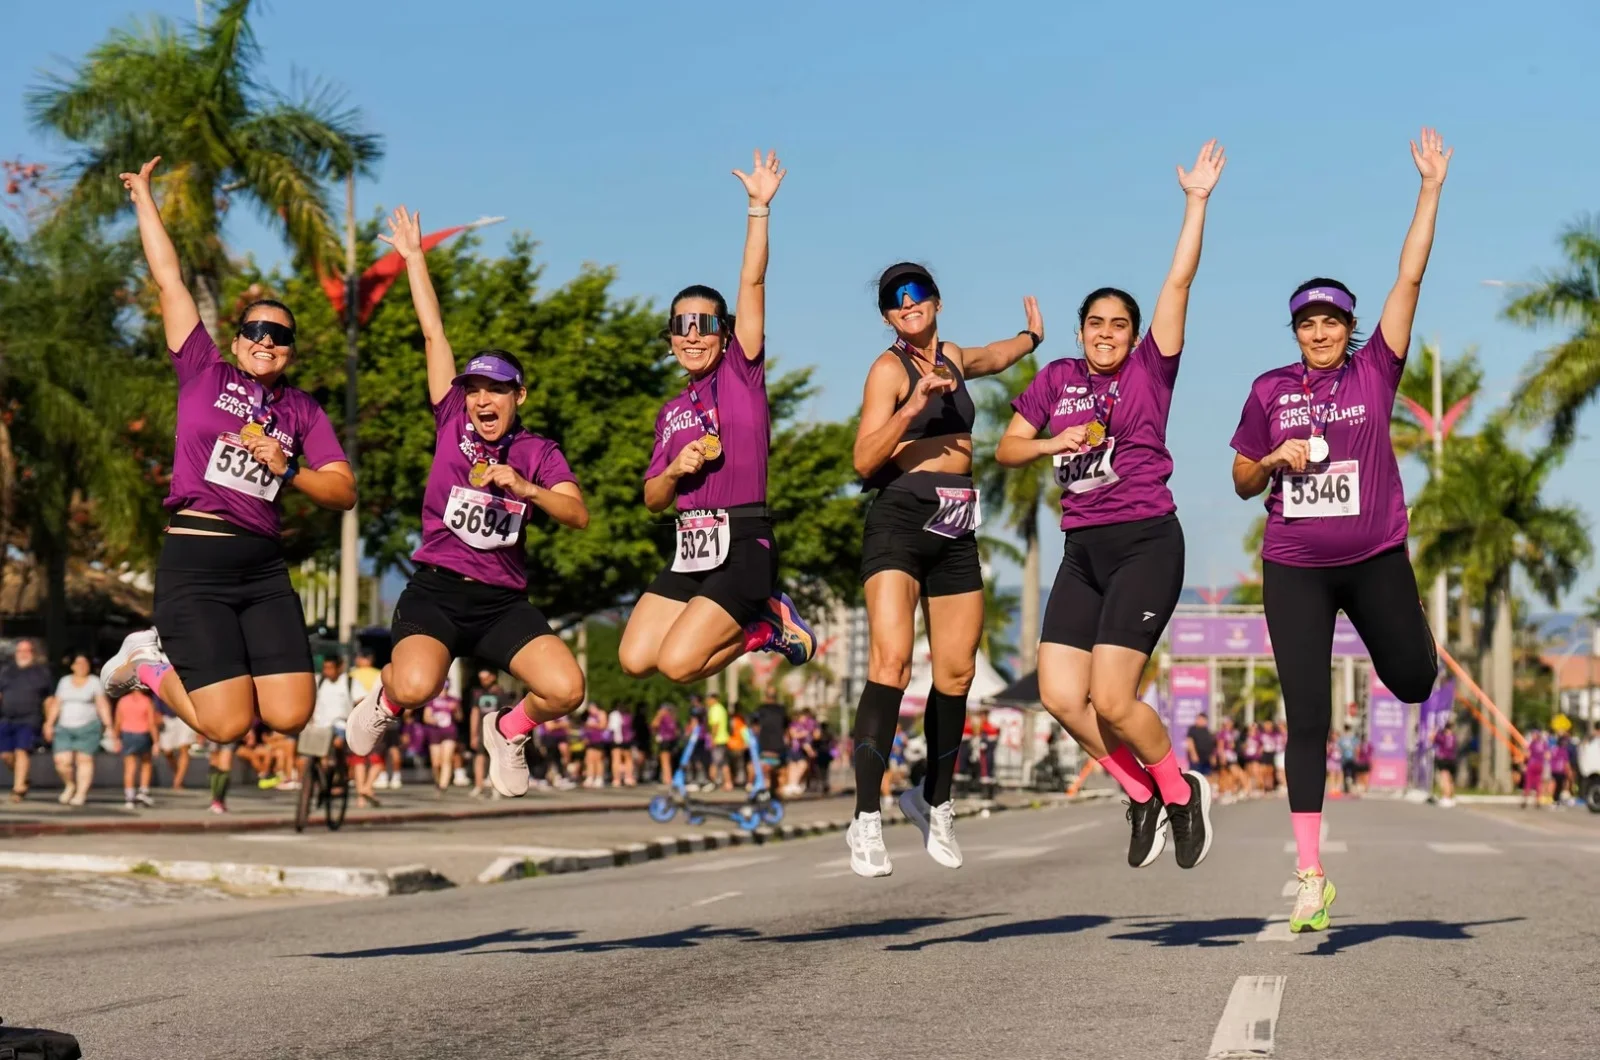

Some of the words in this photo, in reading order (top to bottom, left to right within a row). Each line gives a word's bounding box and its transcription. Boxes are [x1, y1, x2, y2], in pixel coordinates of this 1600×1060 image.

[213, 399, 245, 418] MAIS
[1280, 415, 1310, 430] MAIS
[1059, 451, 1106, 483] 5322
[1290, 474, 1351, 505] 5346
[451, 502, 513, 541] 5694
[681, 527, 720, 561] 5321
